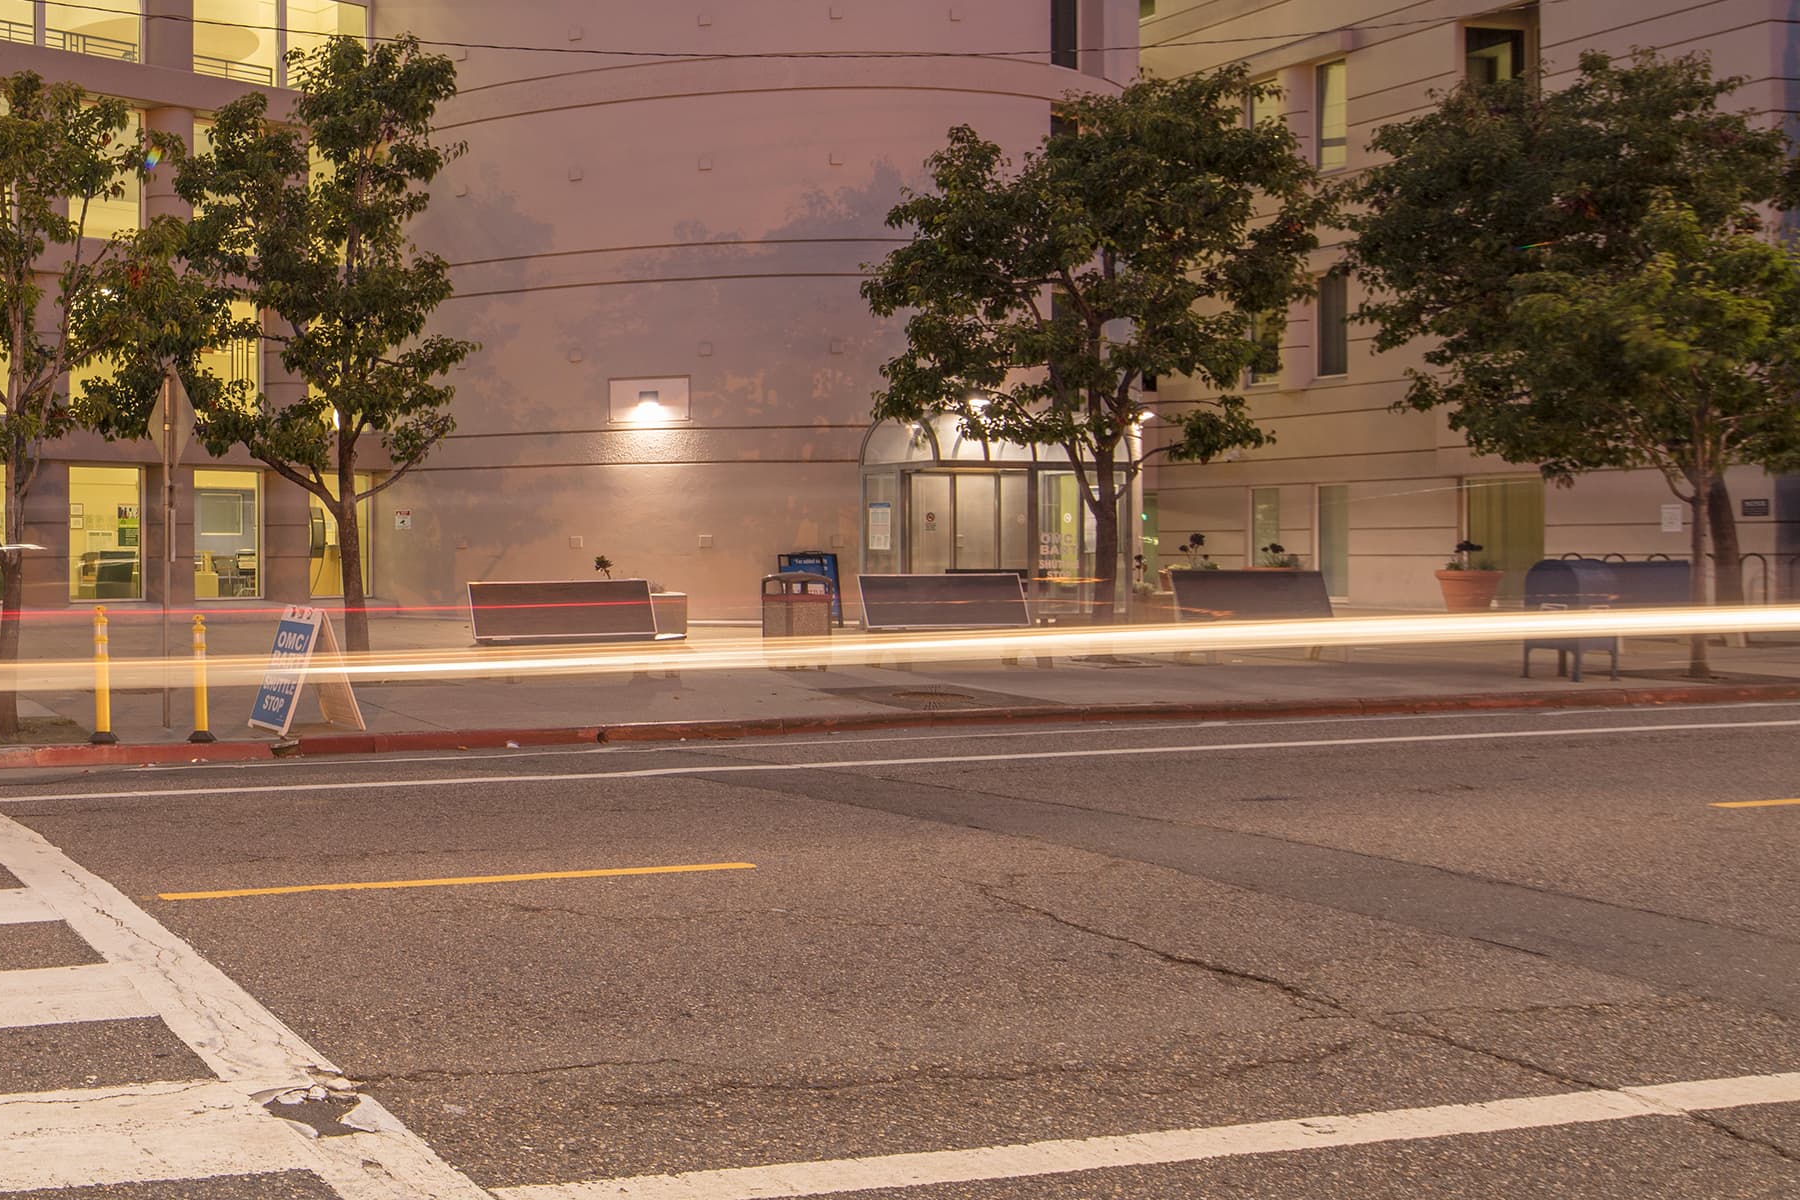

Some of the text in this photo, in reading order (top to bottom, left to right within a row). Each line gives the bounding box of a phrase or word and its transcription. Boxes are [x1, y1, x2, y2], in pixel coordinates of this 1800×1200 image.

[1038, 560, 1080, 570] SHUT
[277, 631, 310, 652] OMC/
[262, 676, 297, 696] SHUTTLE
[262, 694, 285, 712] STOP
